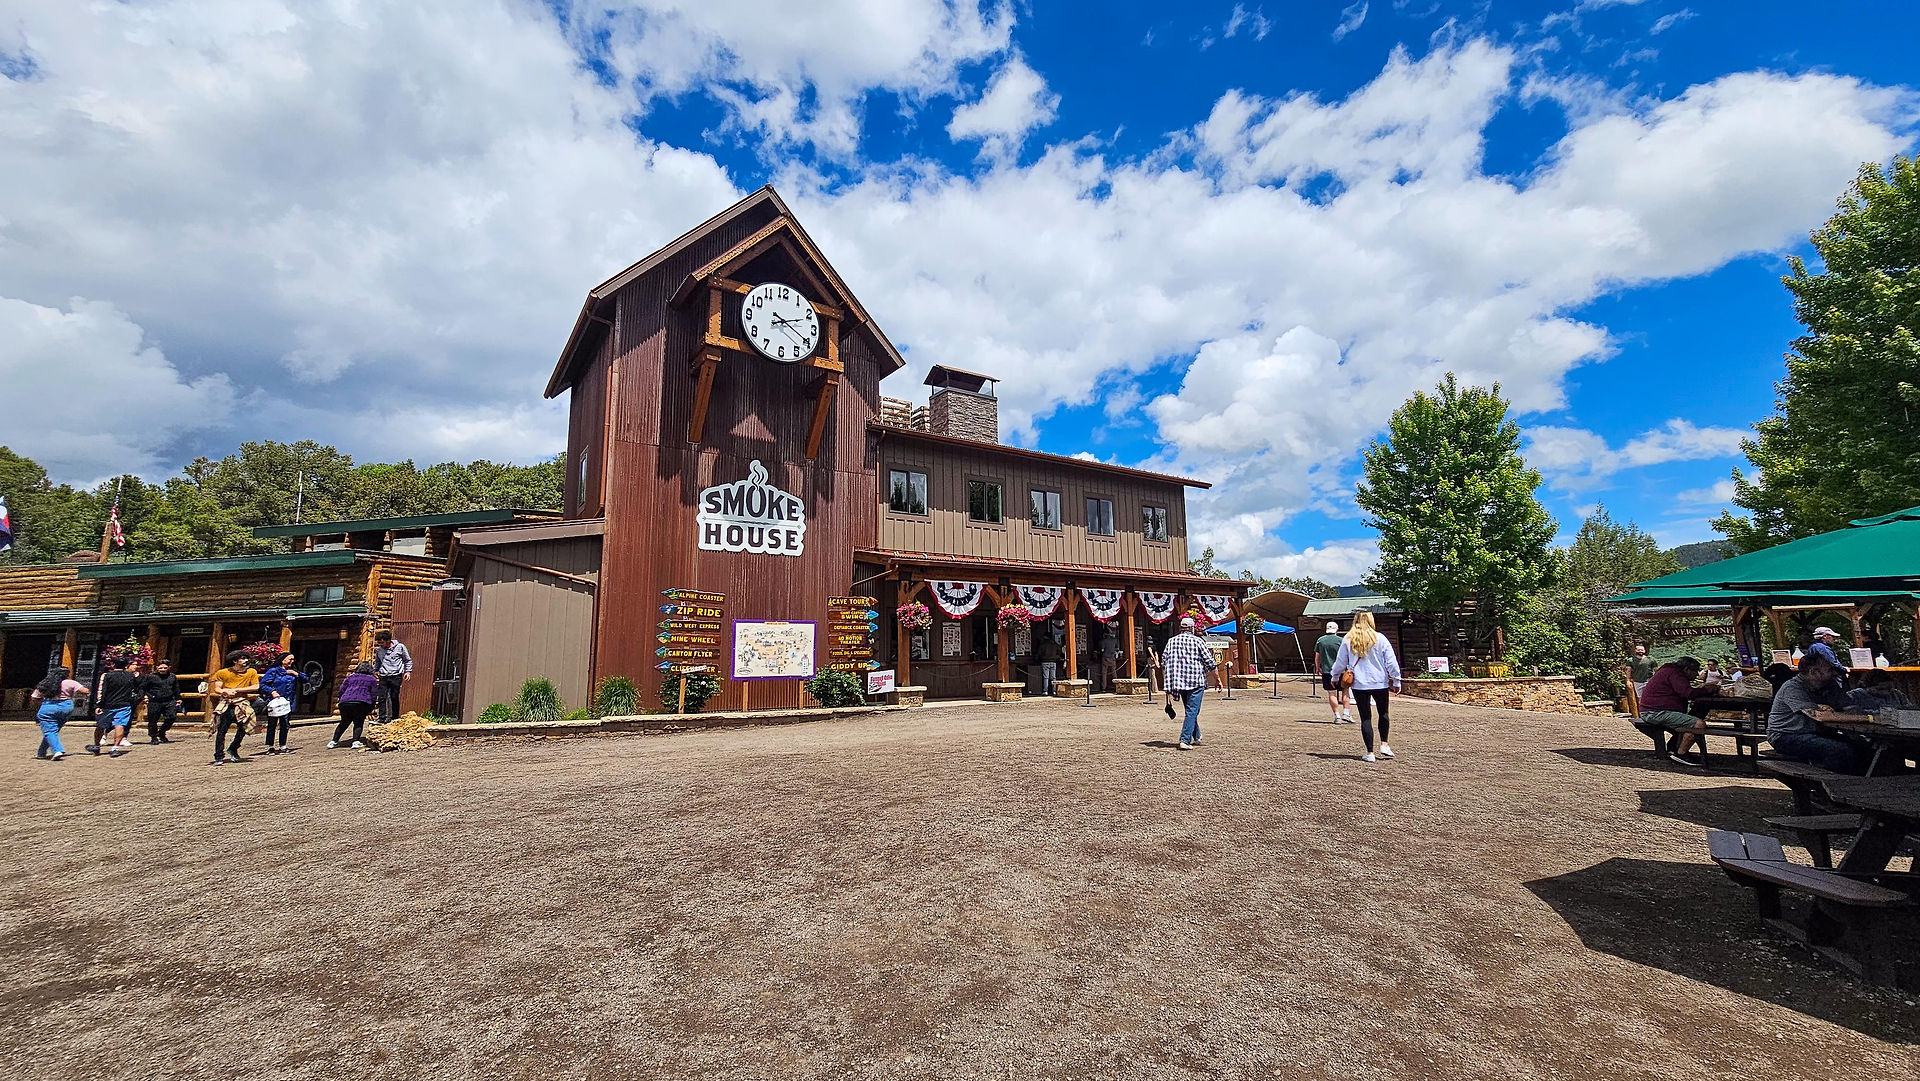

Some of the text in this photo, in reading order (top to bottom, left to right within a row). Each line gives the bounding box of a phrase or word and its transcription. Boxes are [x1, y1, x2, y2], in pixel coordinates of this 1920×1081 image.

[765, 288, 772, 300] 11
[778, 287, 789, 299] 12
[752, 295, 763, 308] 10
[746, 308, 752, 320] 9
[806, 309, 812, 320] 2
[752, 325, 758, 337] 8
[811, 325, 817, 336] 3
[764, 338, 770, 350] 7
[778, 346, 784, 357] 6
[794, 346, 799, 357] 5
[705, 485, 799, 521] SMOKE
[705, 523, 798, 550] HOUSE
[697, 608, 720, 617] RIDE
[1664, 628, 1698, 636] CAVERS
